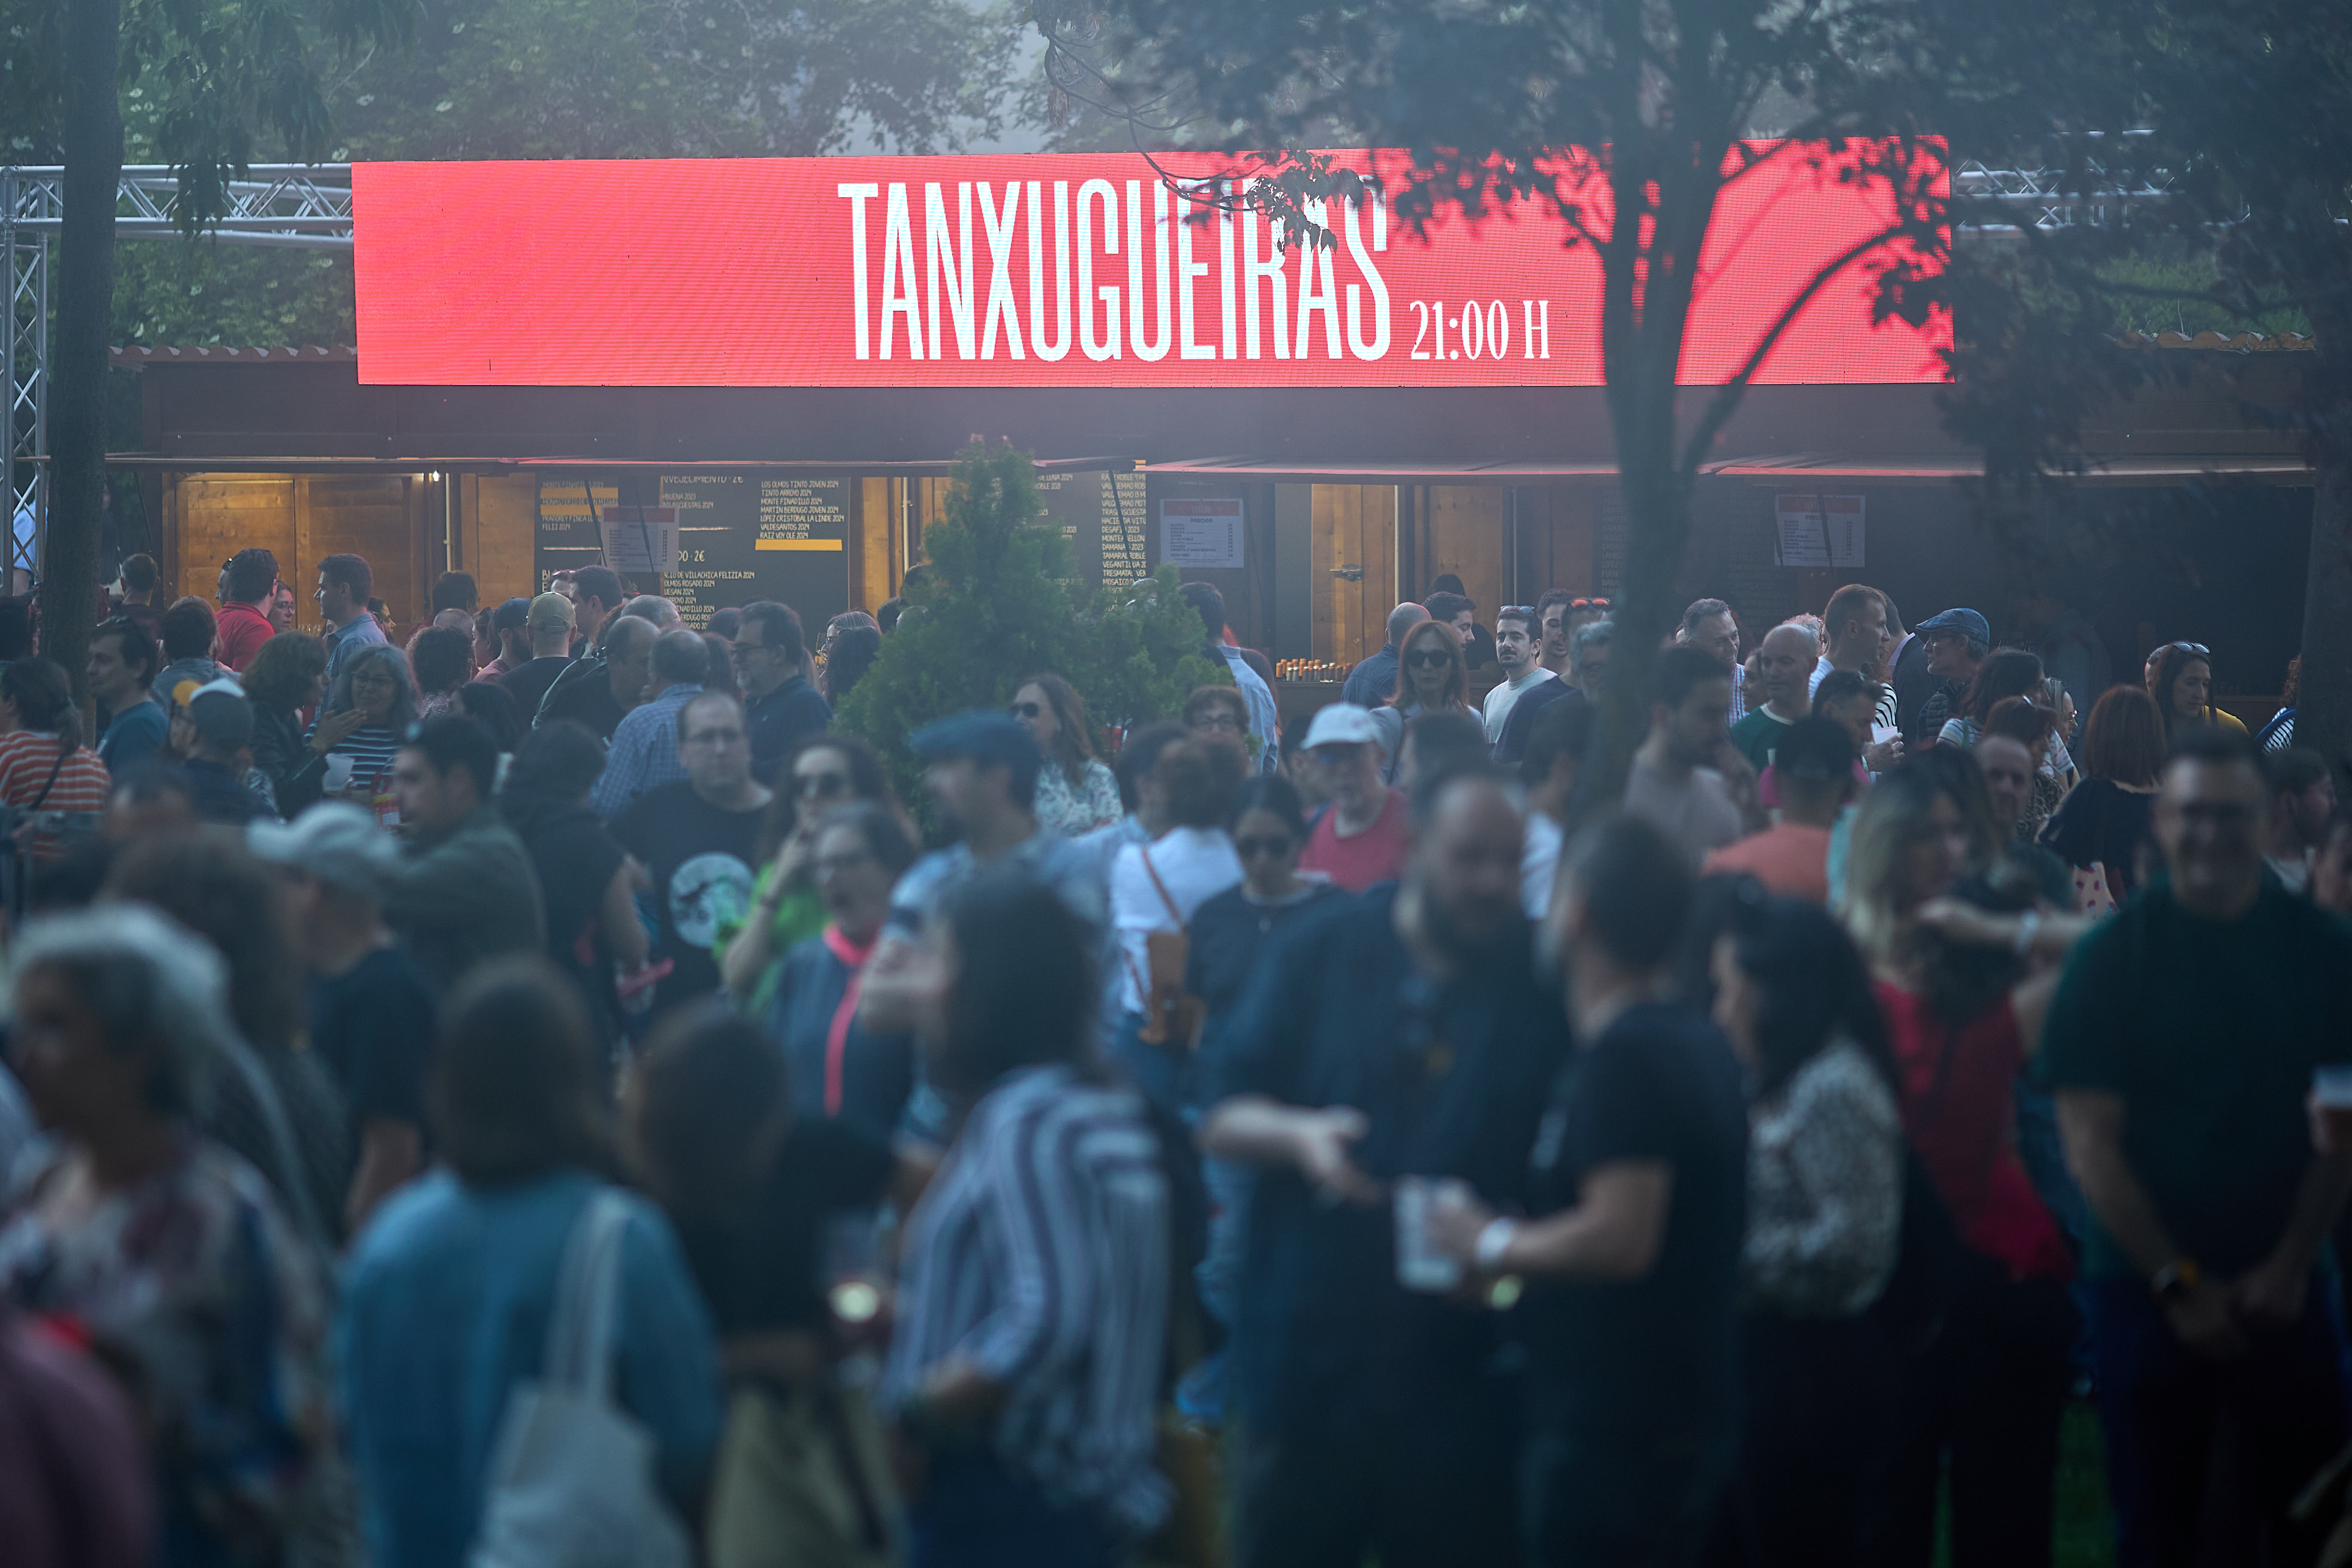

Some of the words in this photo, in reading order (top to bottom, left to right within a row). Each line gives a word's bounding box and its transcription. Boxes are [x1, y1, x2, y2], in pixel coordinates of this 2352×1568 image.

[837, 178, 1391, 362] TANXUGUEIRAS
[1410, 300, 1510, 361] 21:00
[1522, 300, 1550, 360] H
[694, 550, 705, 561] 2€
